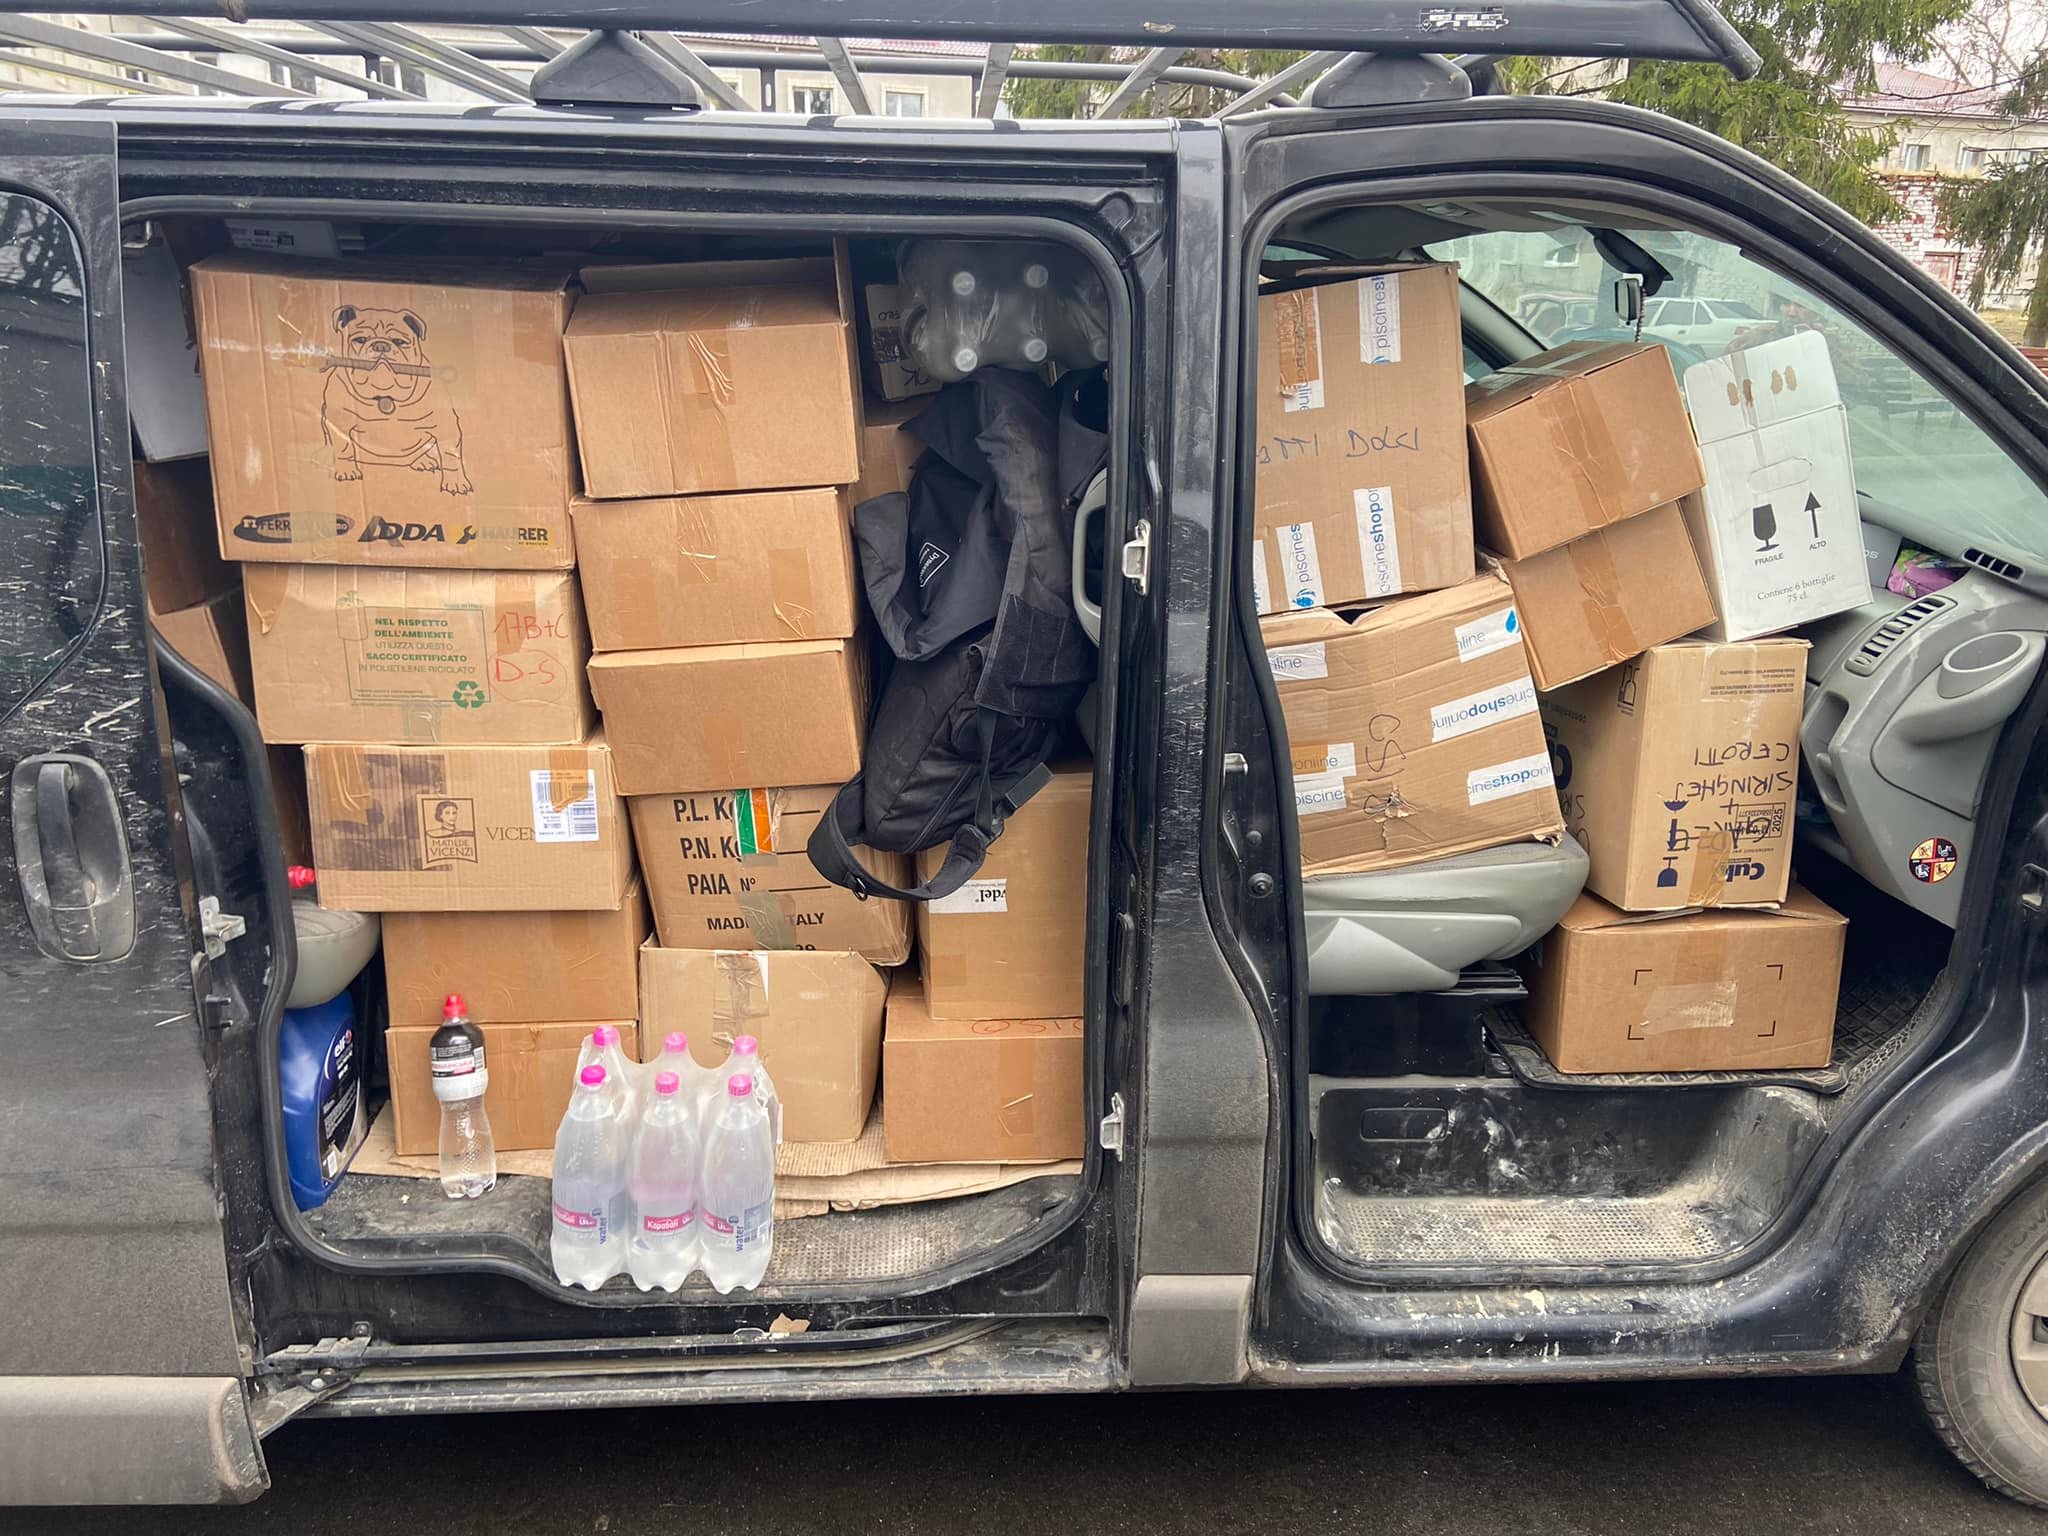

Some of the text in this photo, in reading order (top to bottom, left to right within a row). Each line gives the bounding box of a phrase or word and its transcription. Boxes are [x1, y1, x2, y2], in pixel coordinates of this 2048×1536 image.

[1809, 540, 1827, 551] ALTO
[1754, 553, 1784, 566] FRAGILE
[1757, 583, 1793, 601] Contiene
[1801, 573, 1836, 590] bottiglie
[374, 617, 449, 628] NEL RISPETTO
[374, 629, 455, 640] DELL'AMBIENTE
[375, 641, 454, 651] UTILIZZA QUESTO
[366, 652, 468, 663] SACCO CERTIFICATO
[1694, 741, 1790, 766] CEROTTI
[673, 798, 709, 823] P.L.
[1772, 808, 1783, 833] 2025
[486, 826, 537, 841] VICEN
[432, 839, 470, 848] MATILDE
[680, 837, 717, 860] P.N.
[429, 847, 474, 858] VICENZI
[687, 873, 732, 896] PAIA
[786, 912, 825, 927] TALY
[599, 1216, 608, 1245] water
[736, 1224, 745, 1252] water
